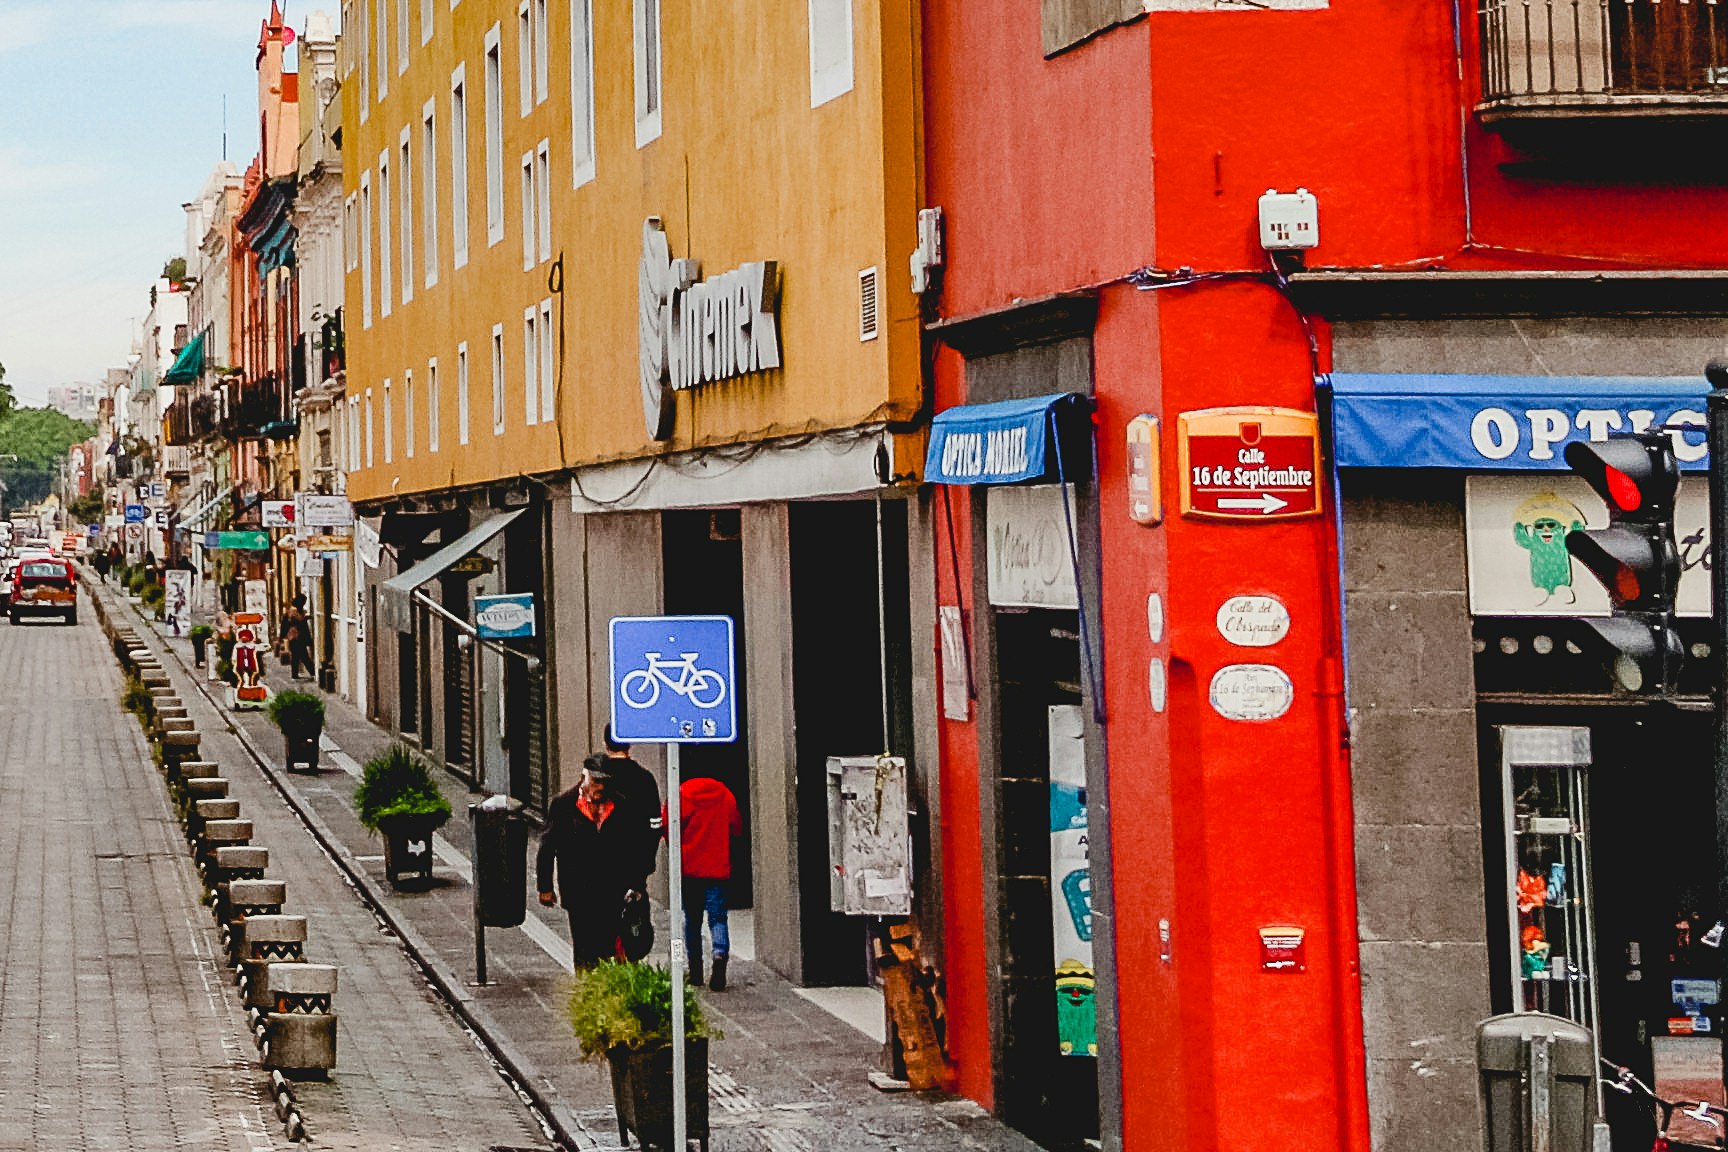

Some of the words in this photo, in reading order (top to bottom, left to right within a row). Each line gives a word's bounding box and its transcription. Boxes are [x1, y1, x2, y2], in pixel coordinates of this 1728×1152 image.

[668, 258, 780, 391] Cinemex
[942, 432, 982, 477] OPTICA
[1238, 448, 1265, 464] Calle
[1192, 467, 1211, 485] 16
[1213, 466, 1231, 486] de
[1234, 466, 1312, 489] Septiembre
[1258, 602, 1272, 613] del
